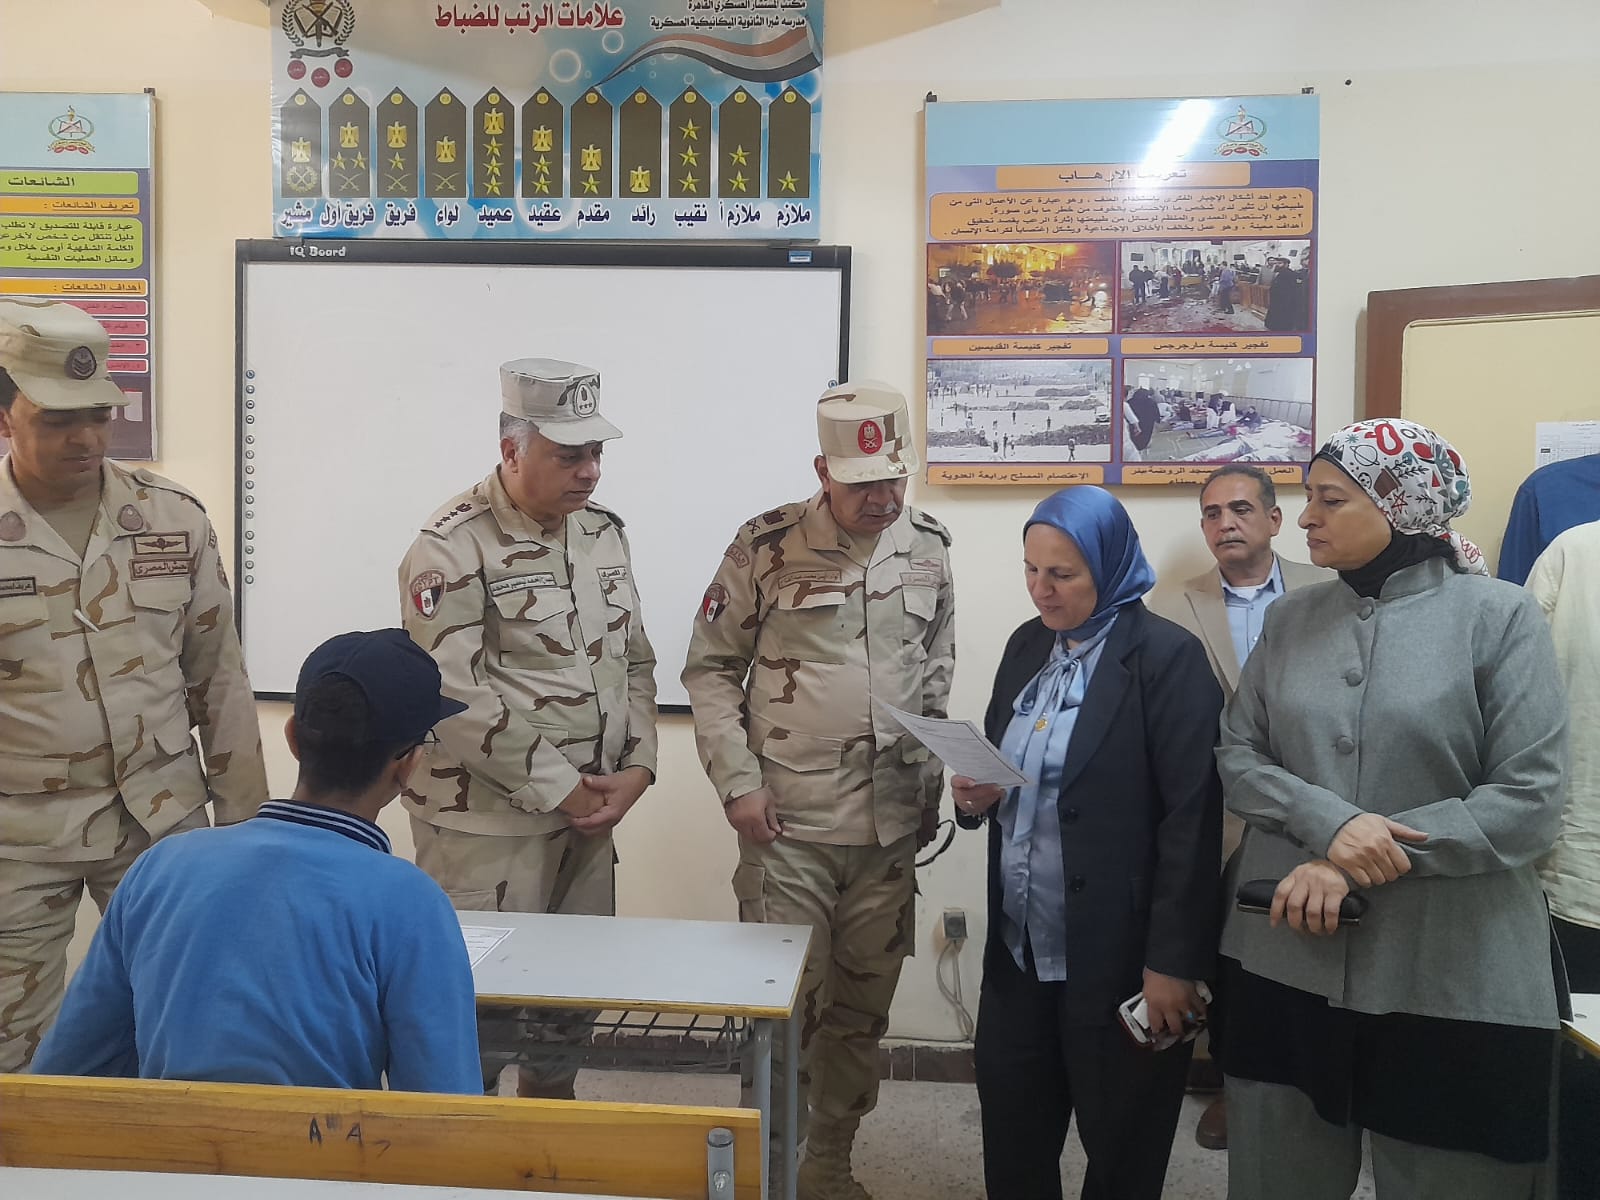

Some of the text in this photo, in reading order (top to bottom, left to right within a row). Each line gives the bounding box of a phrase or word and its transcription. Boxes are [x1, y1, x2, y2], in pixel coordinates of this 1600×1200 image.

[435, 2, 623, 34] علامات الرتب للضباط
[650, 16, 690, 29] العسكرية
[690, 16, 737, 29] الميكانيكية
[738, 15, 764, 29] الثانوية
[281, 202, 312, 227] مشير
[320, 201, 374, 227] فريق أول
[385, 203, 416, 227] فريق
[436, 204, 459, 226] لواء
[478, 203, 513, 227] عميد
[528, 203, 562, 227] عقيد
[577, 203, 610, 227] مقدم
[631, 203, 656, 226] رائد
[674, 203, 707, 227] نقيب
[727, 203, 761, 227] ملازم
[776, 203, 811, 227] ملازم
[71, 234, 86, 242] من
[309, 246, 346, 257] Board
